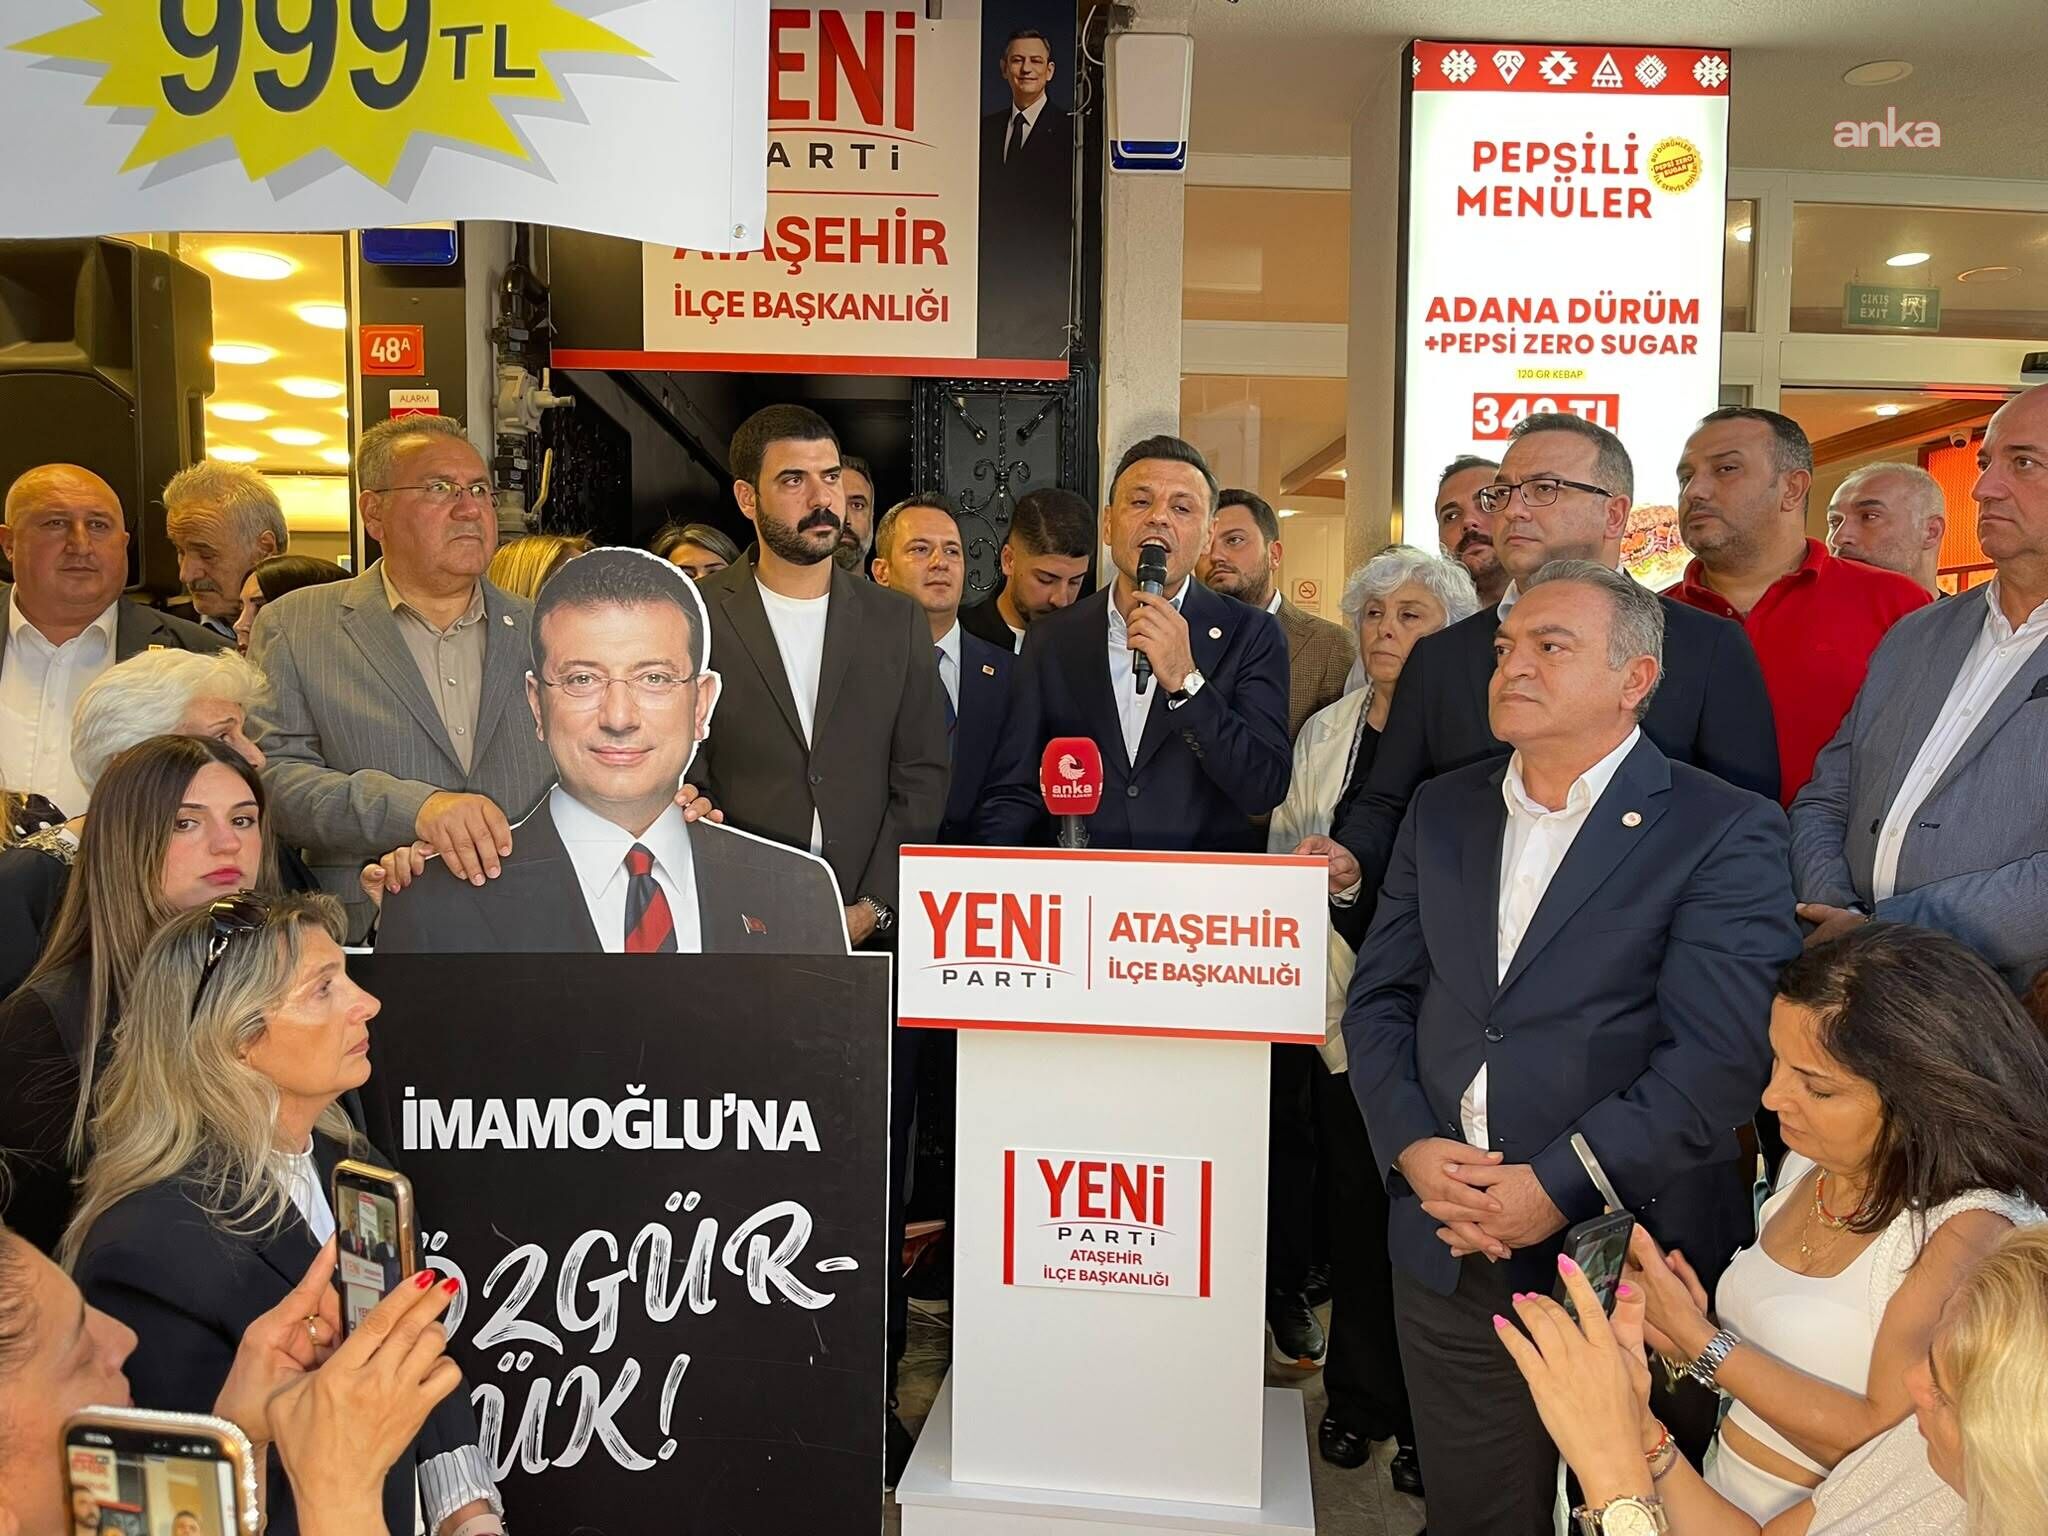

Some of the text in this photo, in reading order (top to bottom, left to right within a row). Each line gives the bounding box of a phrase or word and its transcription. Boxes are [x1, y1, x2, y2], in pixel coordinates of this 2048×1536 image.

[160, 0, 536, 116] 999 TL
[1473, 132, 1638, 174] PEPSİLİ
[1457, 176, 1652, 218] MENÜLER
[674, 283, 948, 326] İLÇE BAŞKANLIĞI
[1425, 290, 1699, 324] ADANA DÜRÜM
[1860, 308, 1888, 319] EXIT
[1524, 334, 1594, 354] ZERO
[1601, 334, 1698, 355] SUGAR
[1518, 369, 1583, 378] 120 GR KEBAP
[1052, 780, 1093, 794] anka
[1109, 909, 1300, 953] ATAŞEHİR
[1109, 957, 1300, 987] İLÇE BAŞKANLIĞI
[403, 1084, 821, 1151] İMAMOĞLU'NA
[1070, 1249, 1143, 1265] ATAŞEHİR
[1044, 1265, 1169, 1286] İLÇE BAŞKANLIĞI
[470, 1351, 691, 1481] ÜK!
